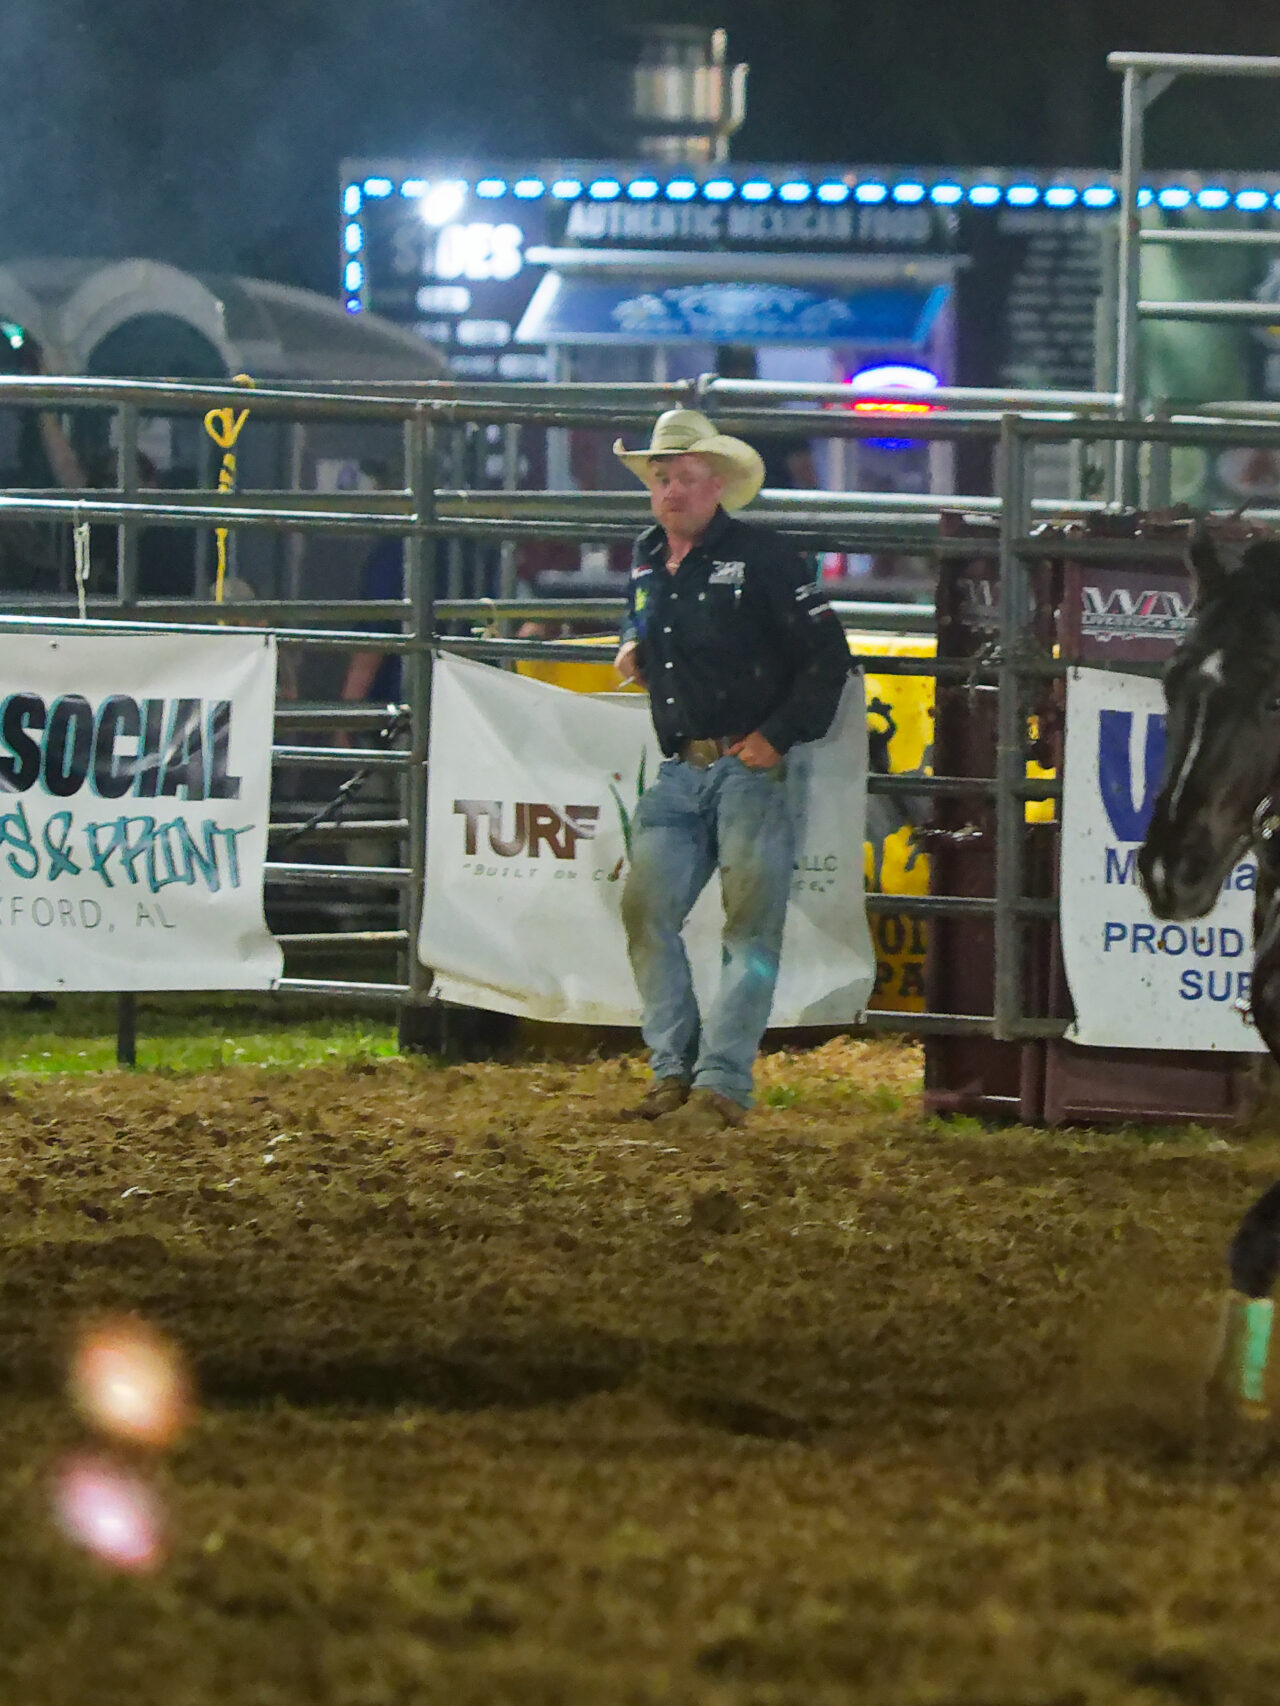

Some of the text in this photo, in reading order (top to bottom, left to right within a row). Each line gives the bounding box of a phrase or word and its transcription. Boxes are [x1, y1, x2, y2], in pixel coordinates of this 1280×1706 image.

[0, 692, 242, 801] SOCIAL
[453, 799, 600, 860] TURF
[0, 895, 116, 933] FORD,
[1104, 921, 1244, 958] PROUD
